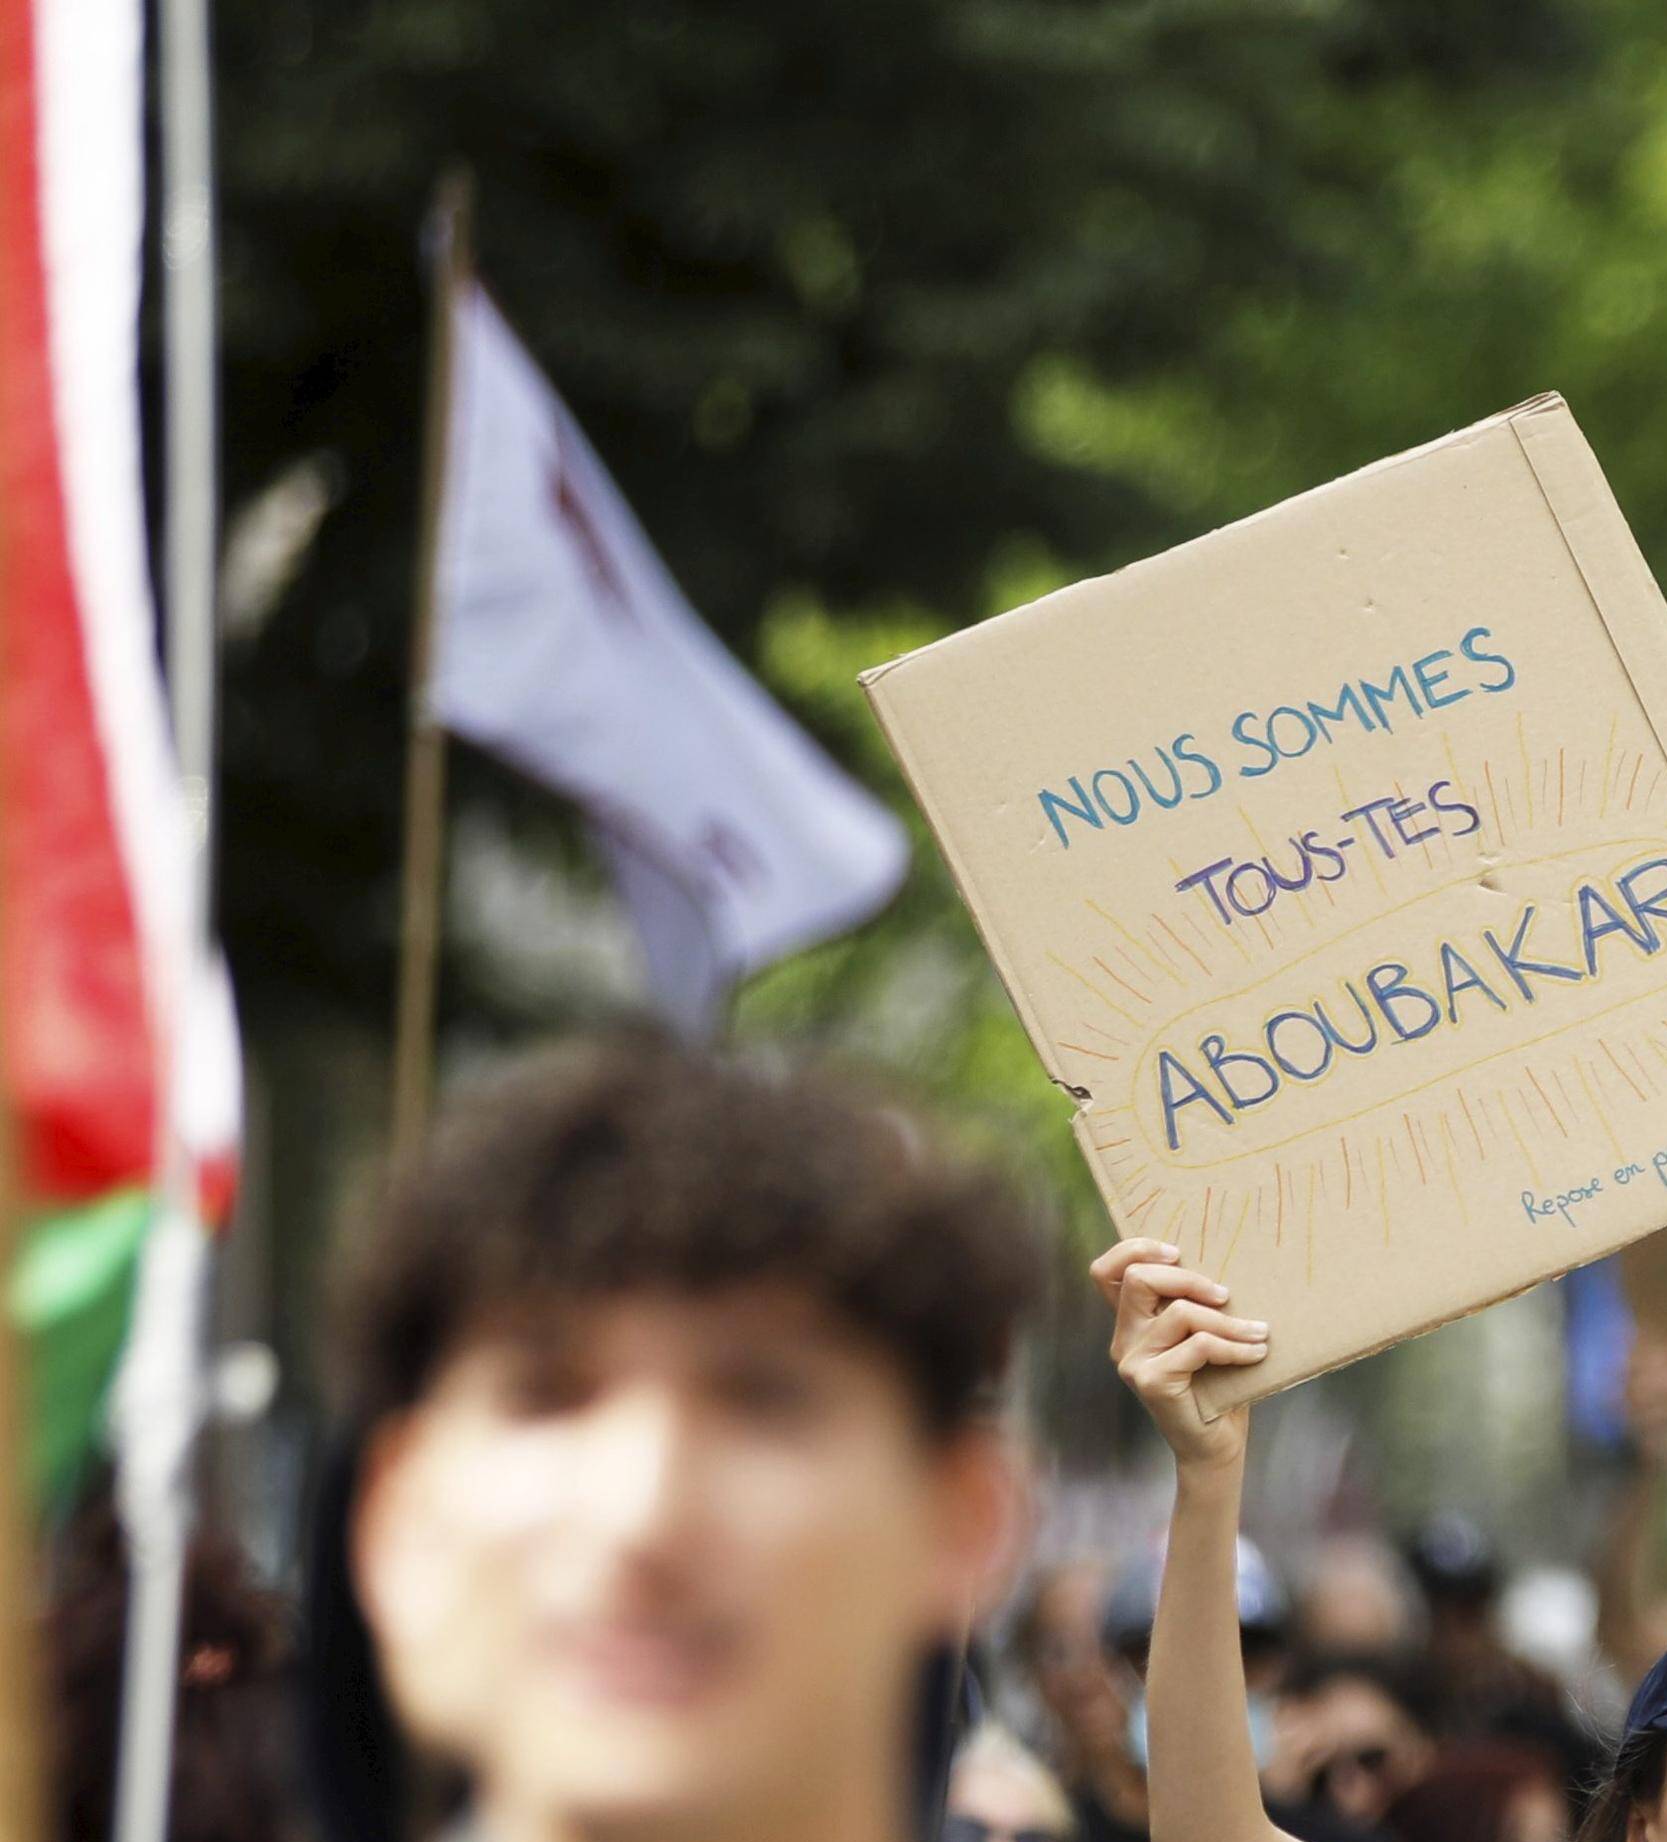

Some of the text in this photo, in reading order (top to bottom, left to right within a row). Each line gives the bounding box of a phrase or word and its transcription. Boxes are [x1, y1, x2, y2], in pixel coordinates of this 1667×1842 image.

[1037, 626, 1516, 849] NOUS SOMMES
[1173, 780, 1481, 926] TOUS-TES
[1520, 1189, 1604, 1229] Repose
[1613, 1162, 1646, 1186] en
